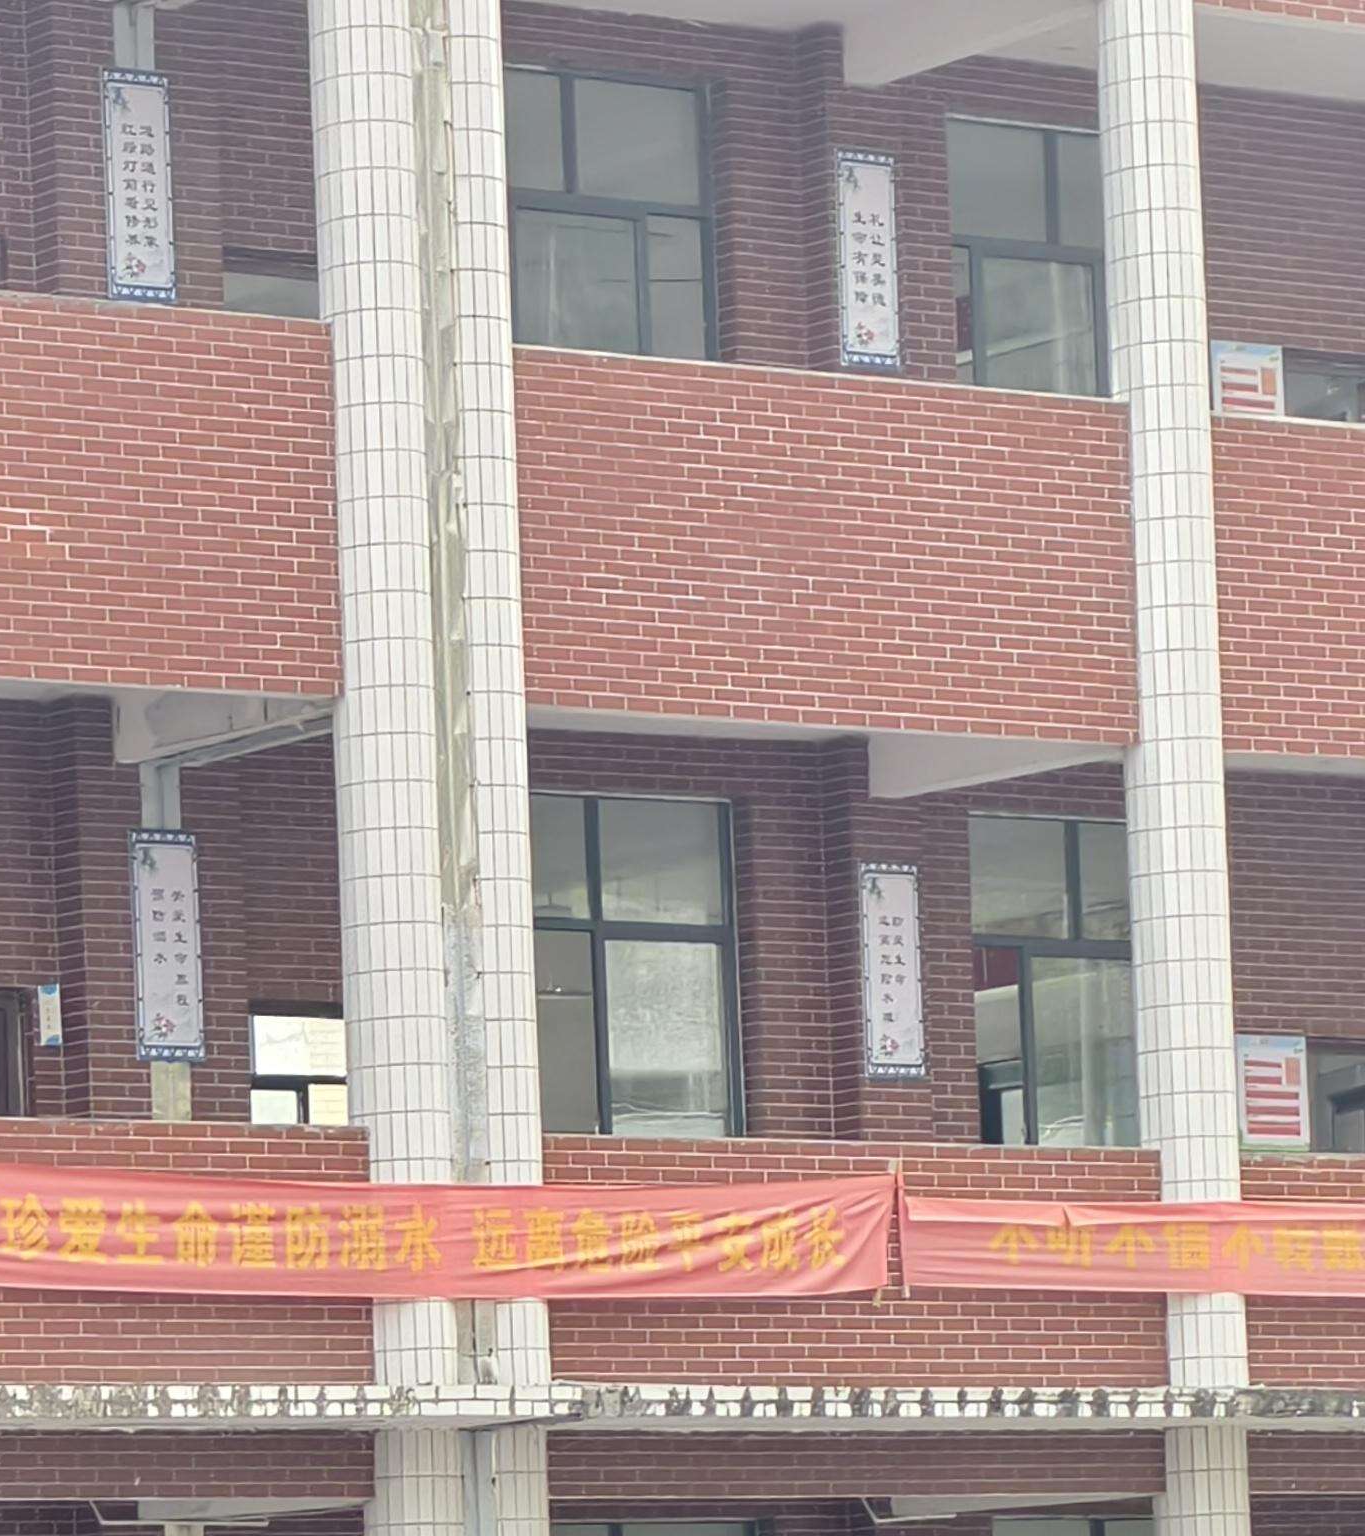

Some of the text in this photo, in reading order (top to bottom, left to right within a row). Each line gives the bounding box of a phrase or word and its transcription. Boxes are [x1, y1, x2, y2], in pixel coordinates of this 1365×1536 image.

[471, 1204, 848, 1274] 远离危险平安成长
